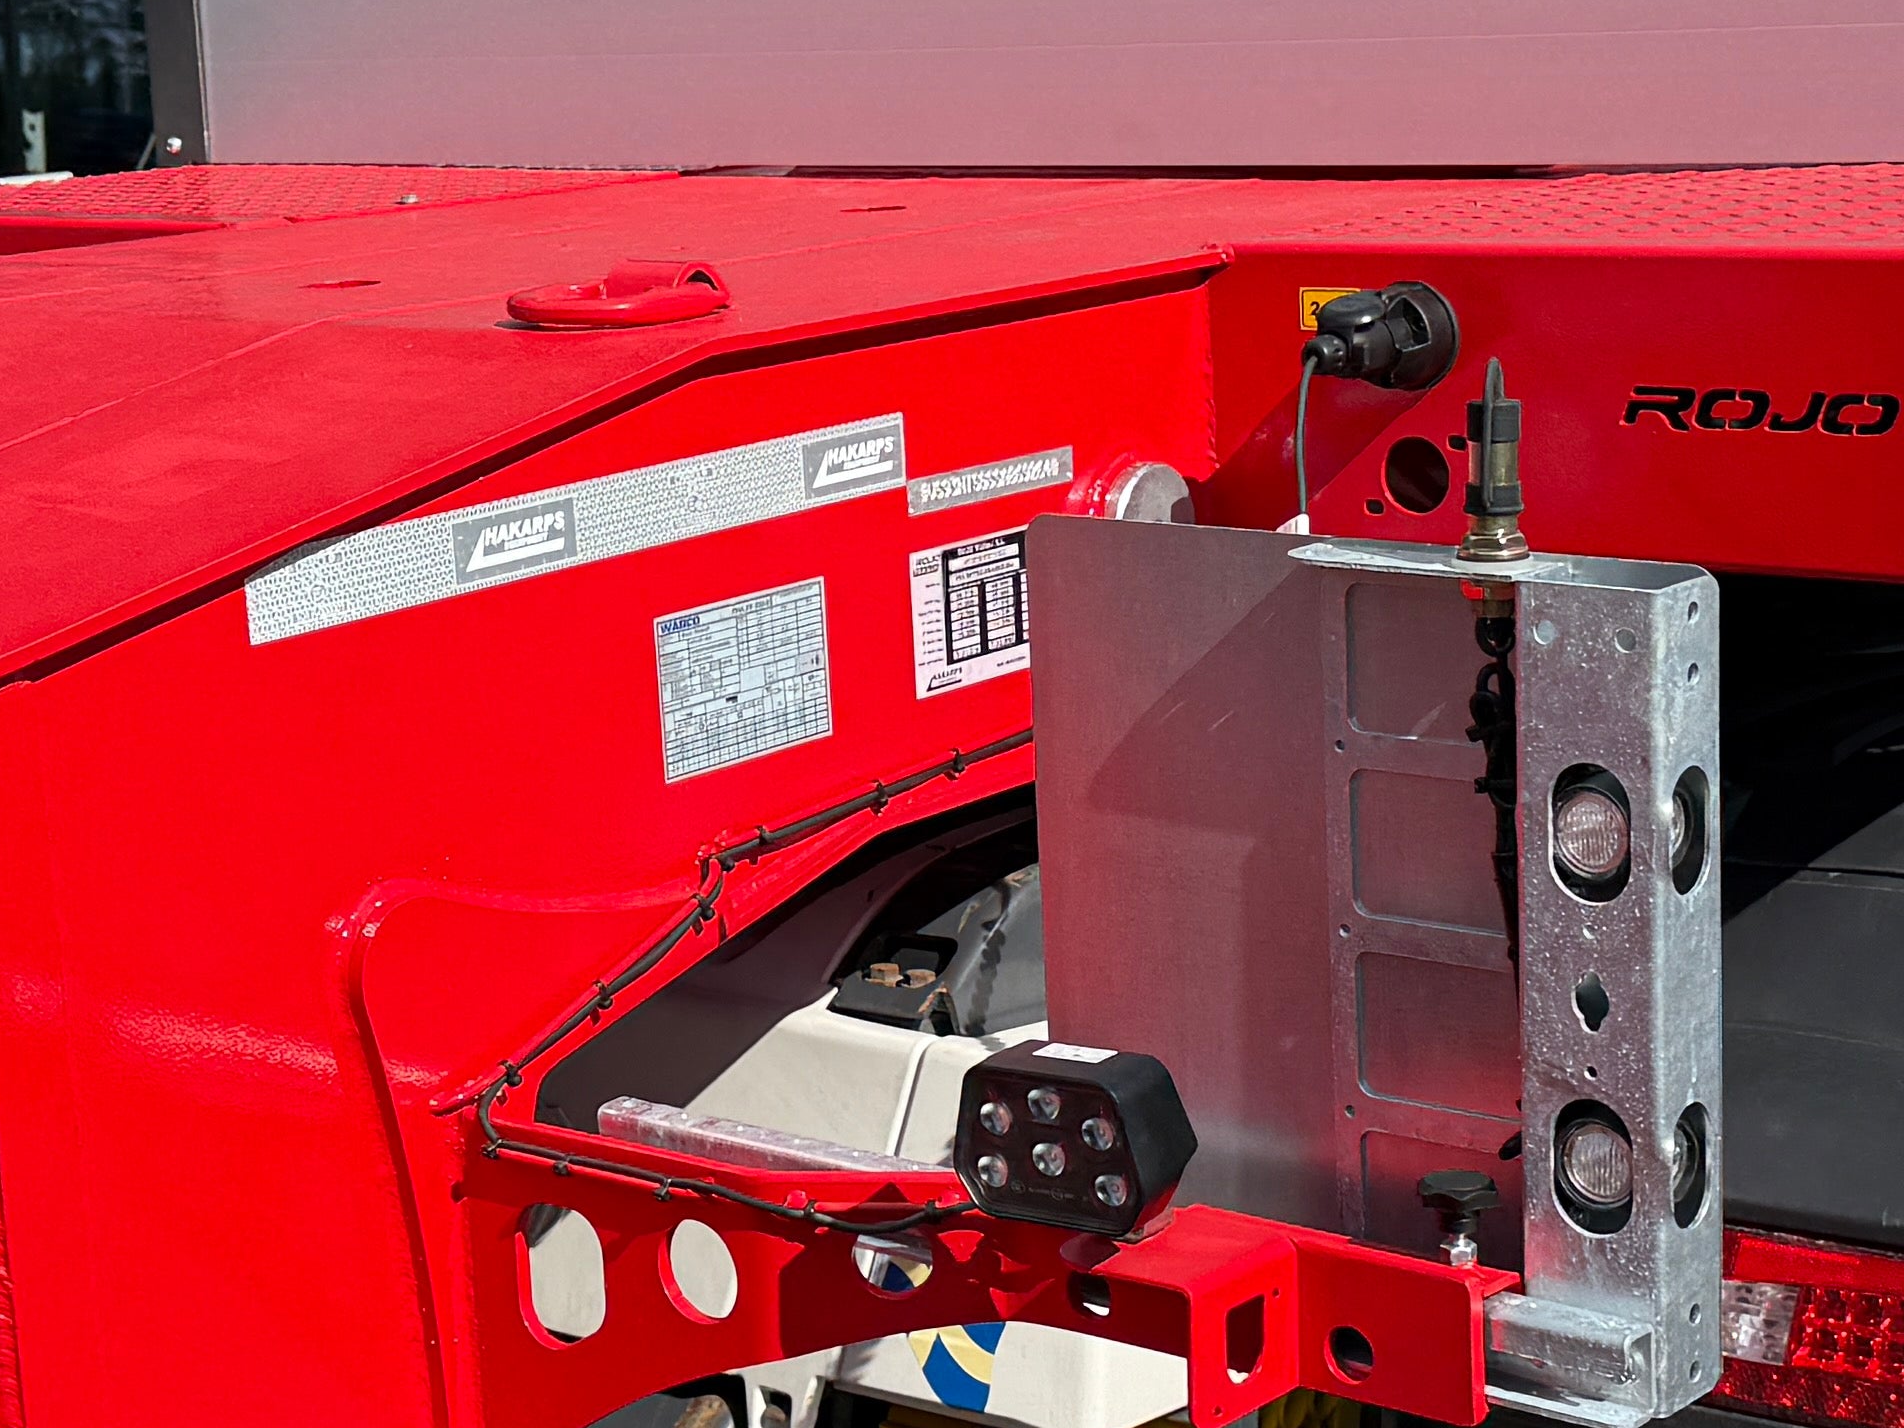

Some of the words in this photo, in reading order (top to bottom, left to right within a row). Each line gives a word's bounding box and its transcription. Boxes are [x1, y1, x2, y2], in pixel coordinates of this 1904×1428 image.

[1622, 384, 1901, 436] ROJO
[827, 435, 895, 470] HAKARPS
[484, 510, 566, 547] HAKARPS
